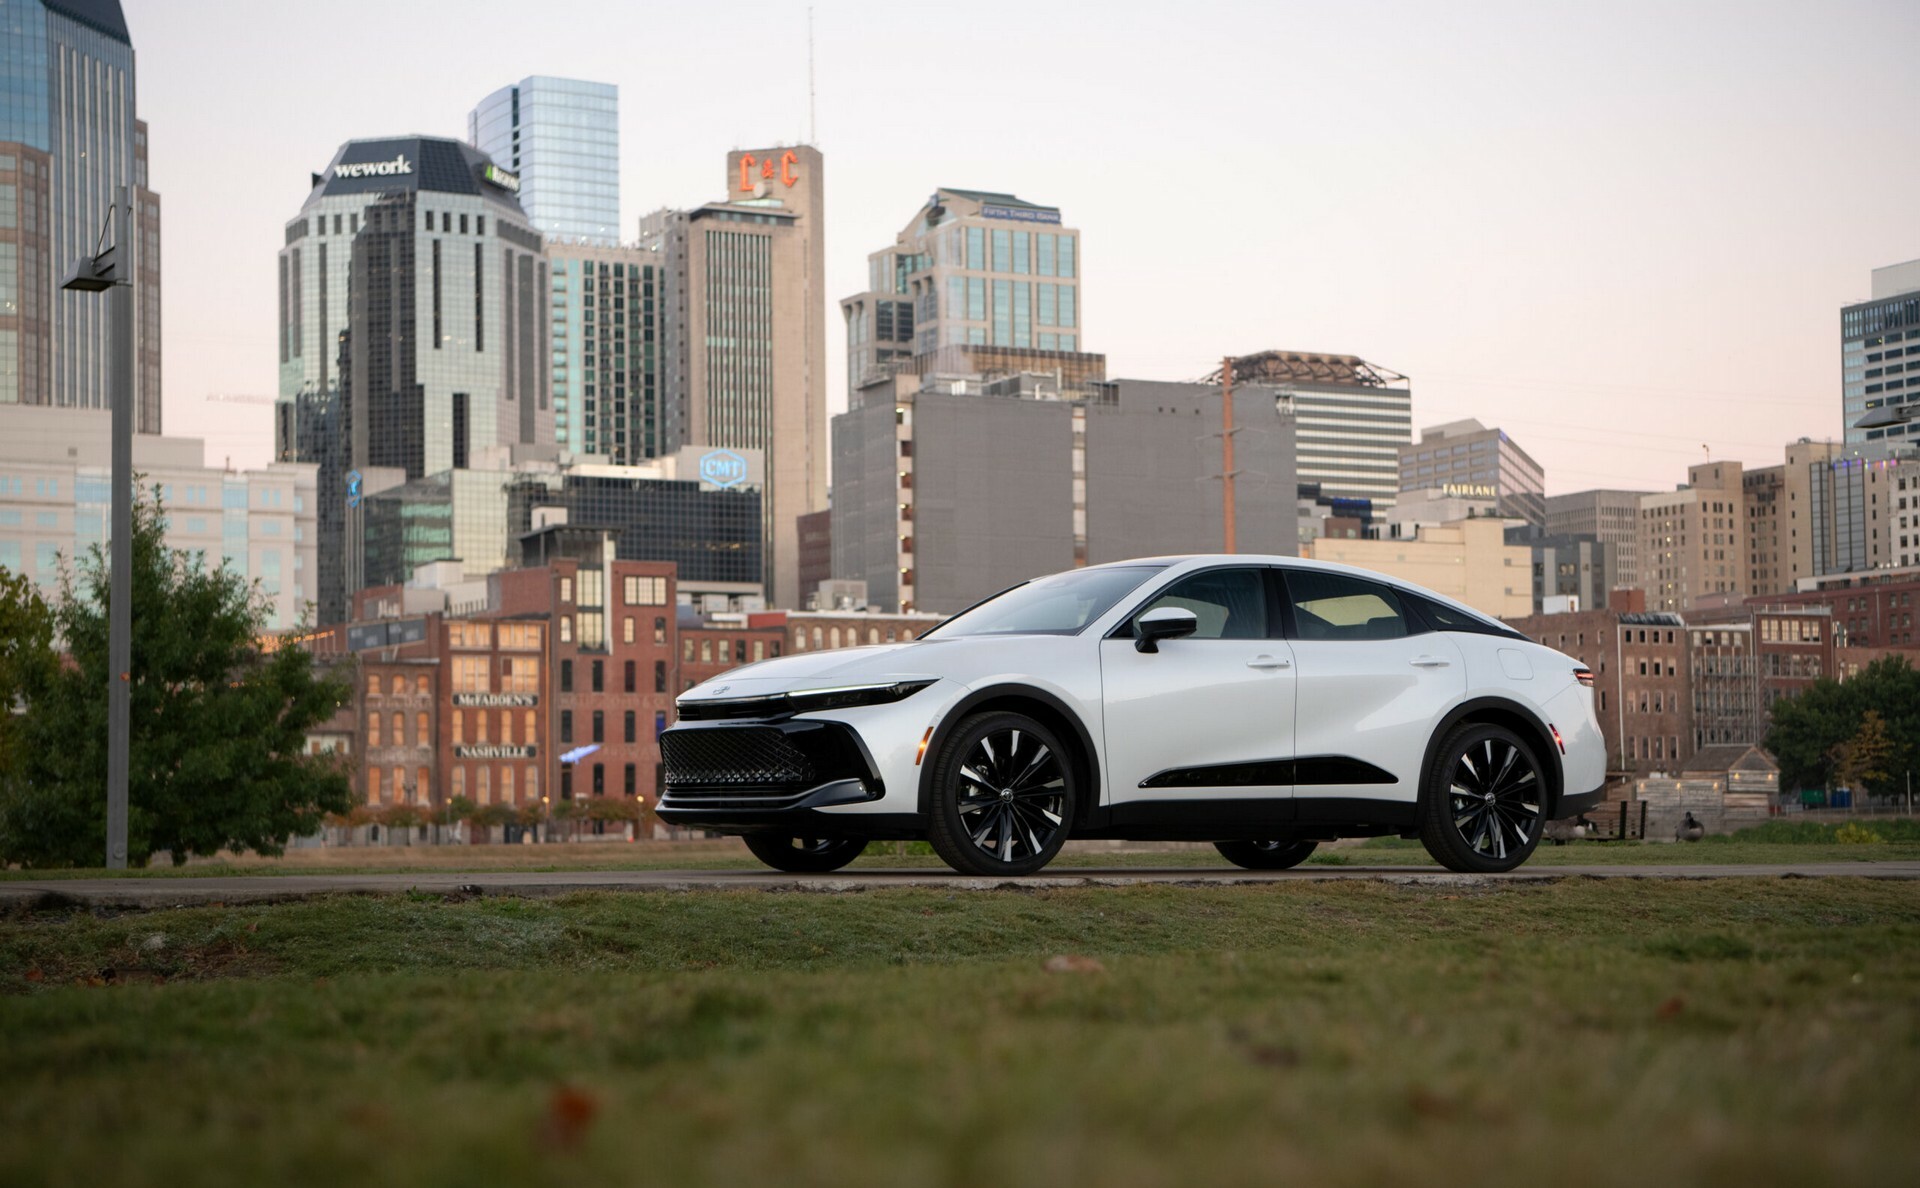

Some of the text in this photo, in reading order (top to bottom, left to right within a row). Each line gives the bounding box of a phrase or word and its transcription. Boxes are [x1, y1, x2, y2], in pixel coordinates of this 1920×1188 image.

[334, 153, 413, 178] wework
[761, 157, 775, 180] &
[781, 149, 799, 188] C
[705, 459, 741, 477] CMT
[1443, 483, 1497, 497] FAIRLANE
[460, 746, 528, 758] NASHVILLE
